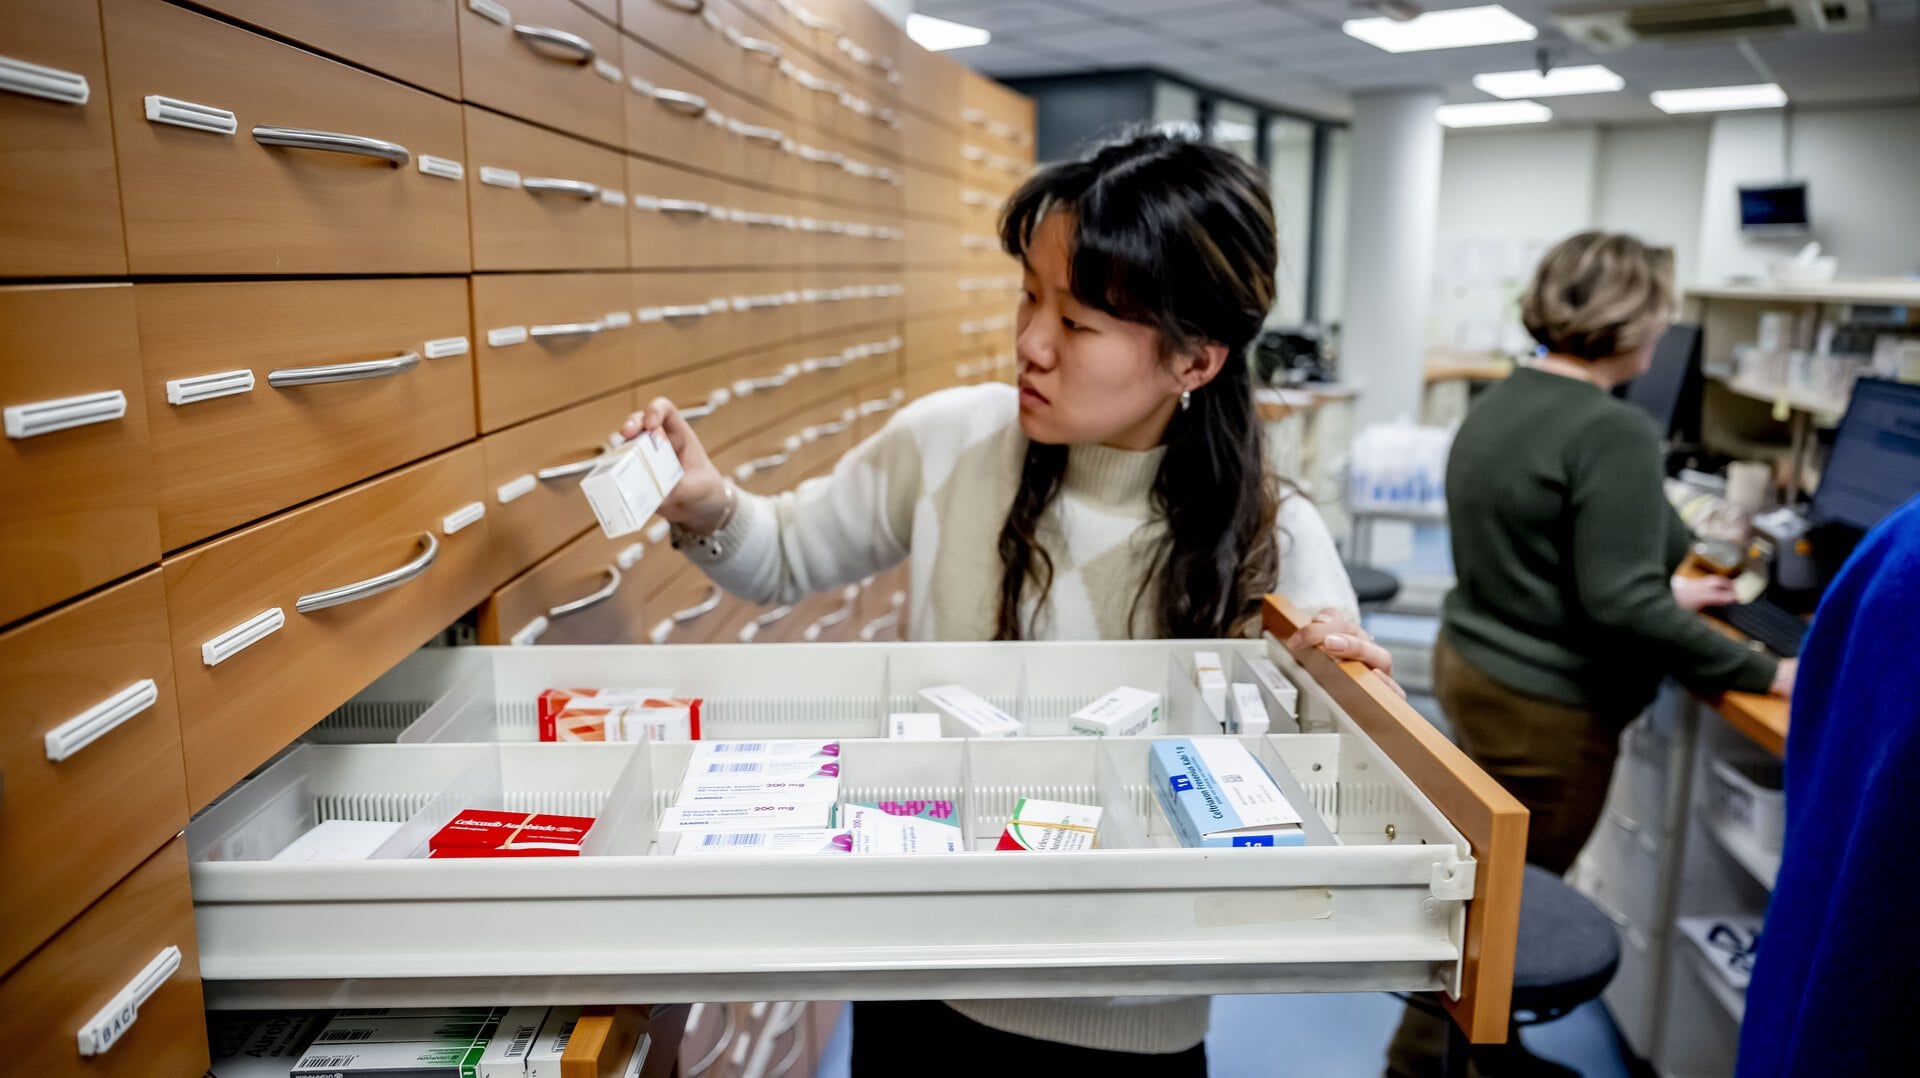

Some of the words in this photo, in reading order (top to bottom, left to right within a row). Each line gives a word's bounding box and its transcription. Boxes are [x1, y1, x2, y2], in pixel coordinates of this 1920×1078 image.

[1179, 754, 1192, 766] Kabi
[1187, 765, 1206, 790] Fresenius
[1201, 789, 1223, 820] Ceftriaxon
[454, 819, 502, 828] Celecoxib
[502, 822, 556, 832] Aurbindo
